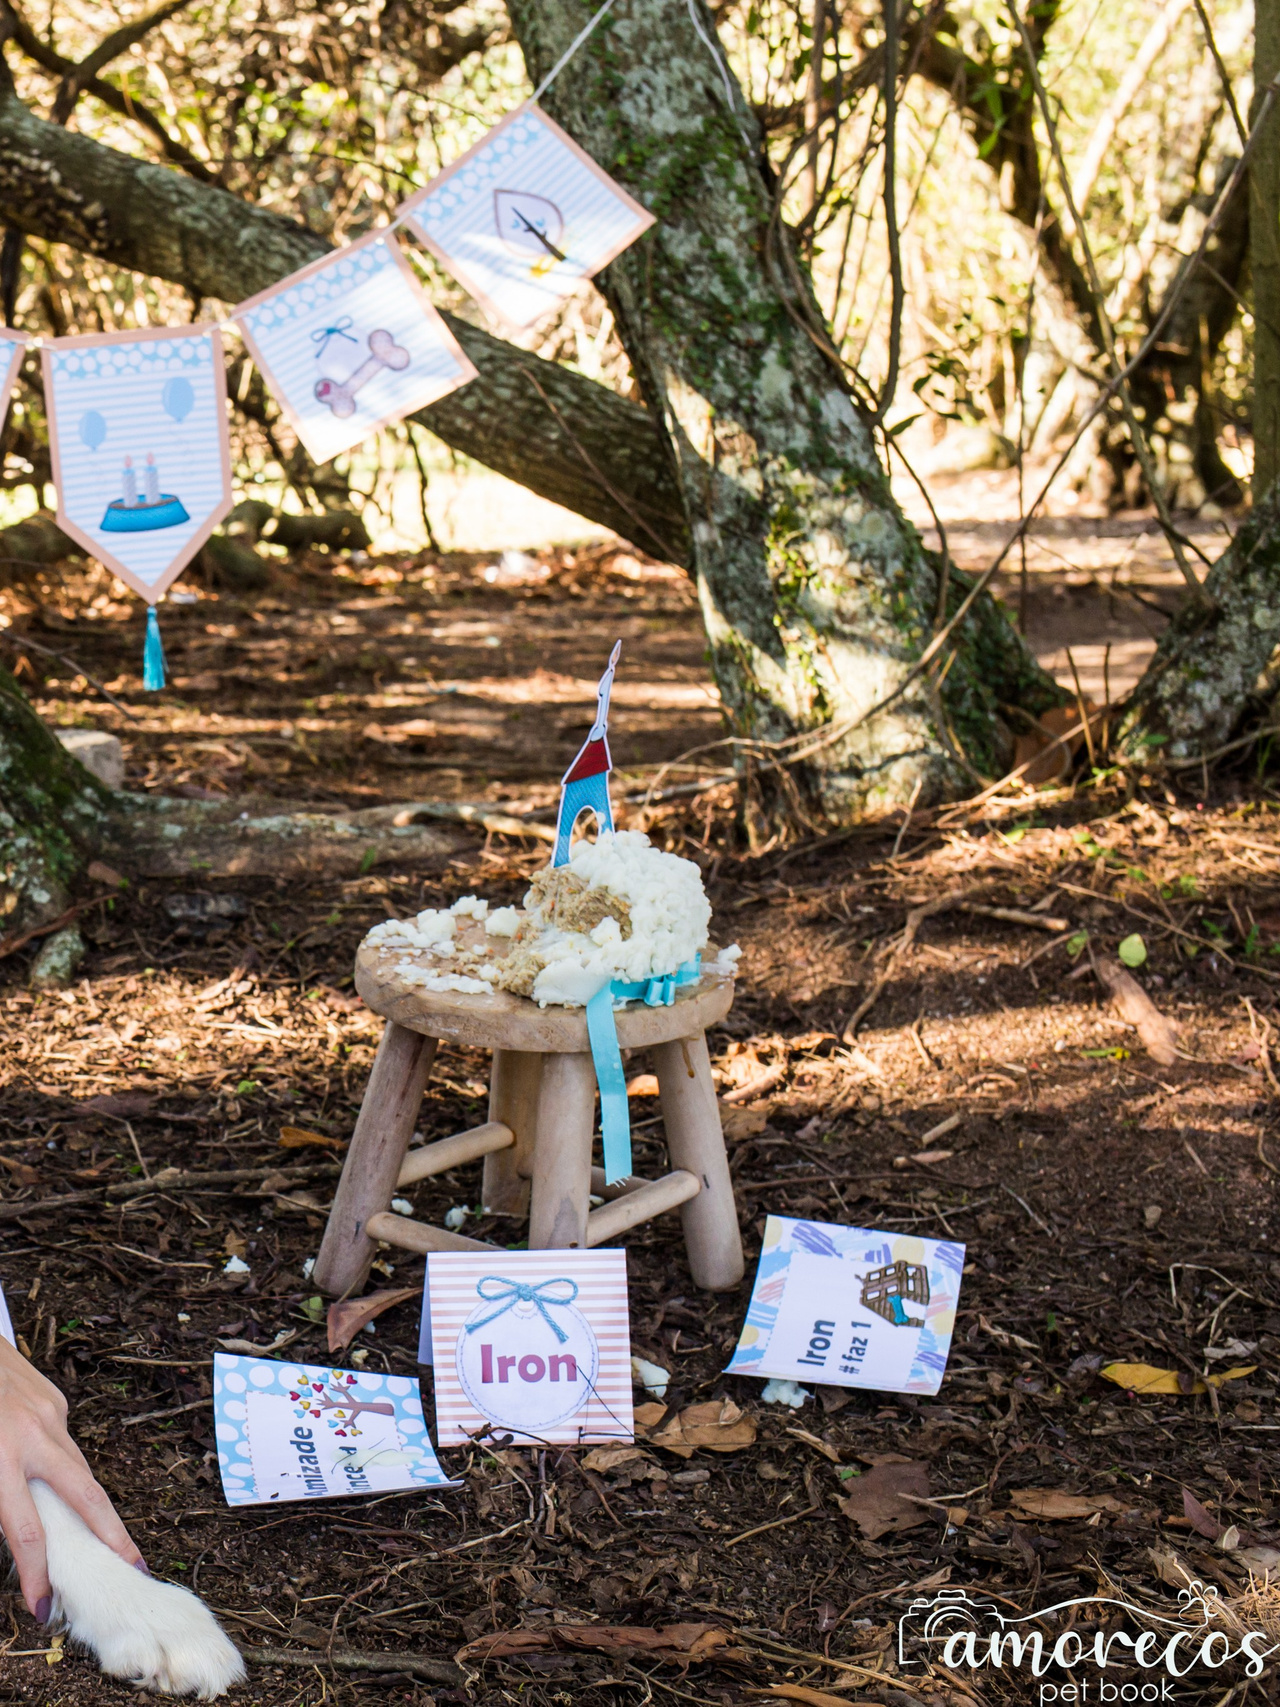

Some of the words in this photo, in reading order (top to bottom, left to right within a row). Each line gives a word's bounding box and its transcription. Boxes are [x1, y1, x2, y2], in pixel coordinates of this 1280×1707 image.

[480, 1344, 577, 1384] Iron
[797, 1320, 836, 1366] Iron
[842, 1337, 868, 1362] faz
[289, 1426, 329, 1497] Amizade
